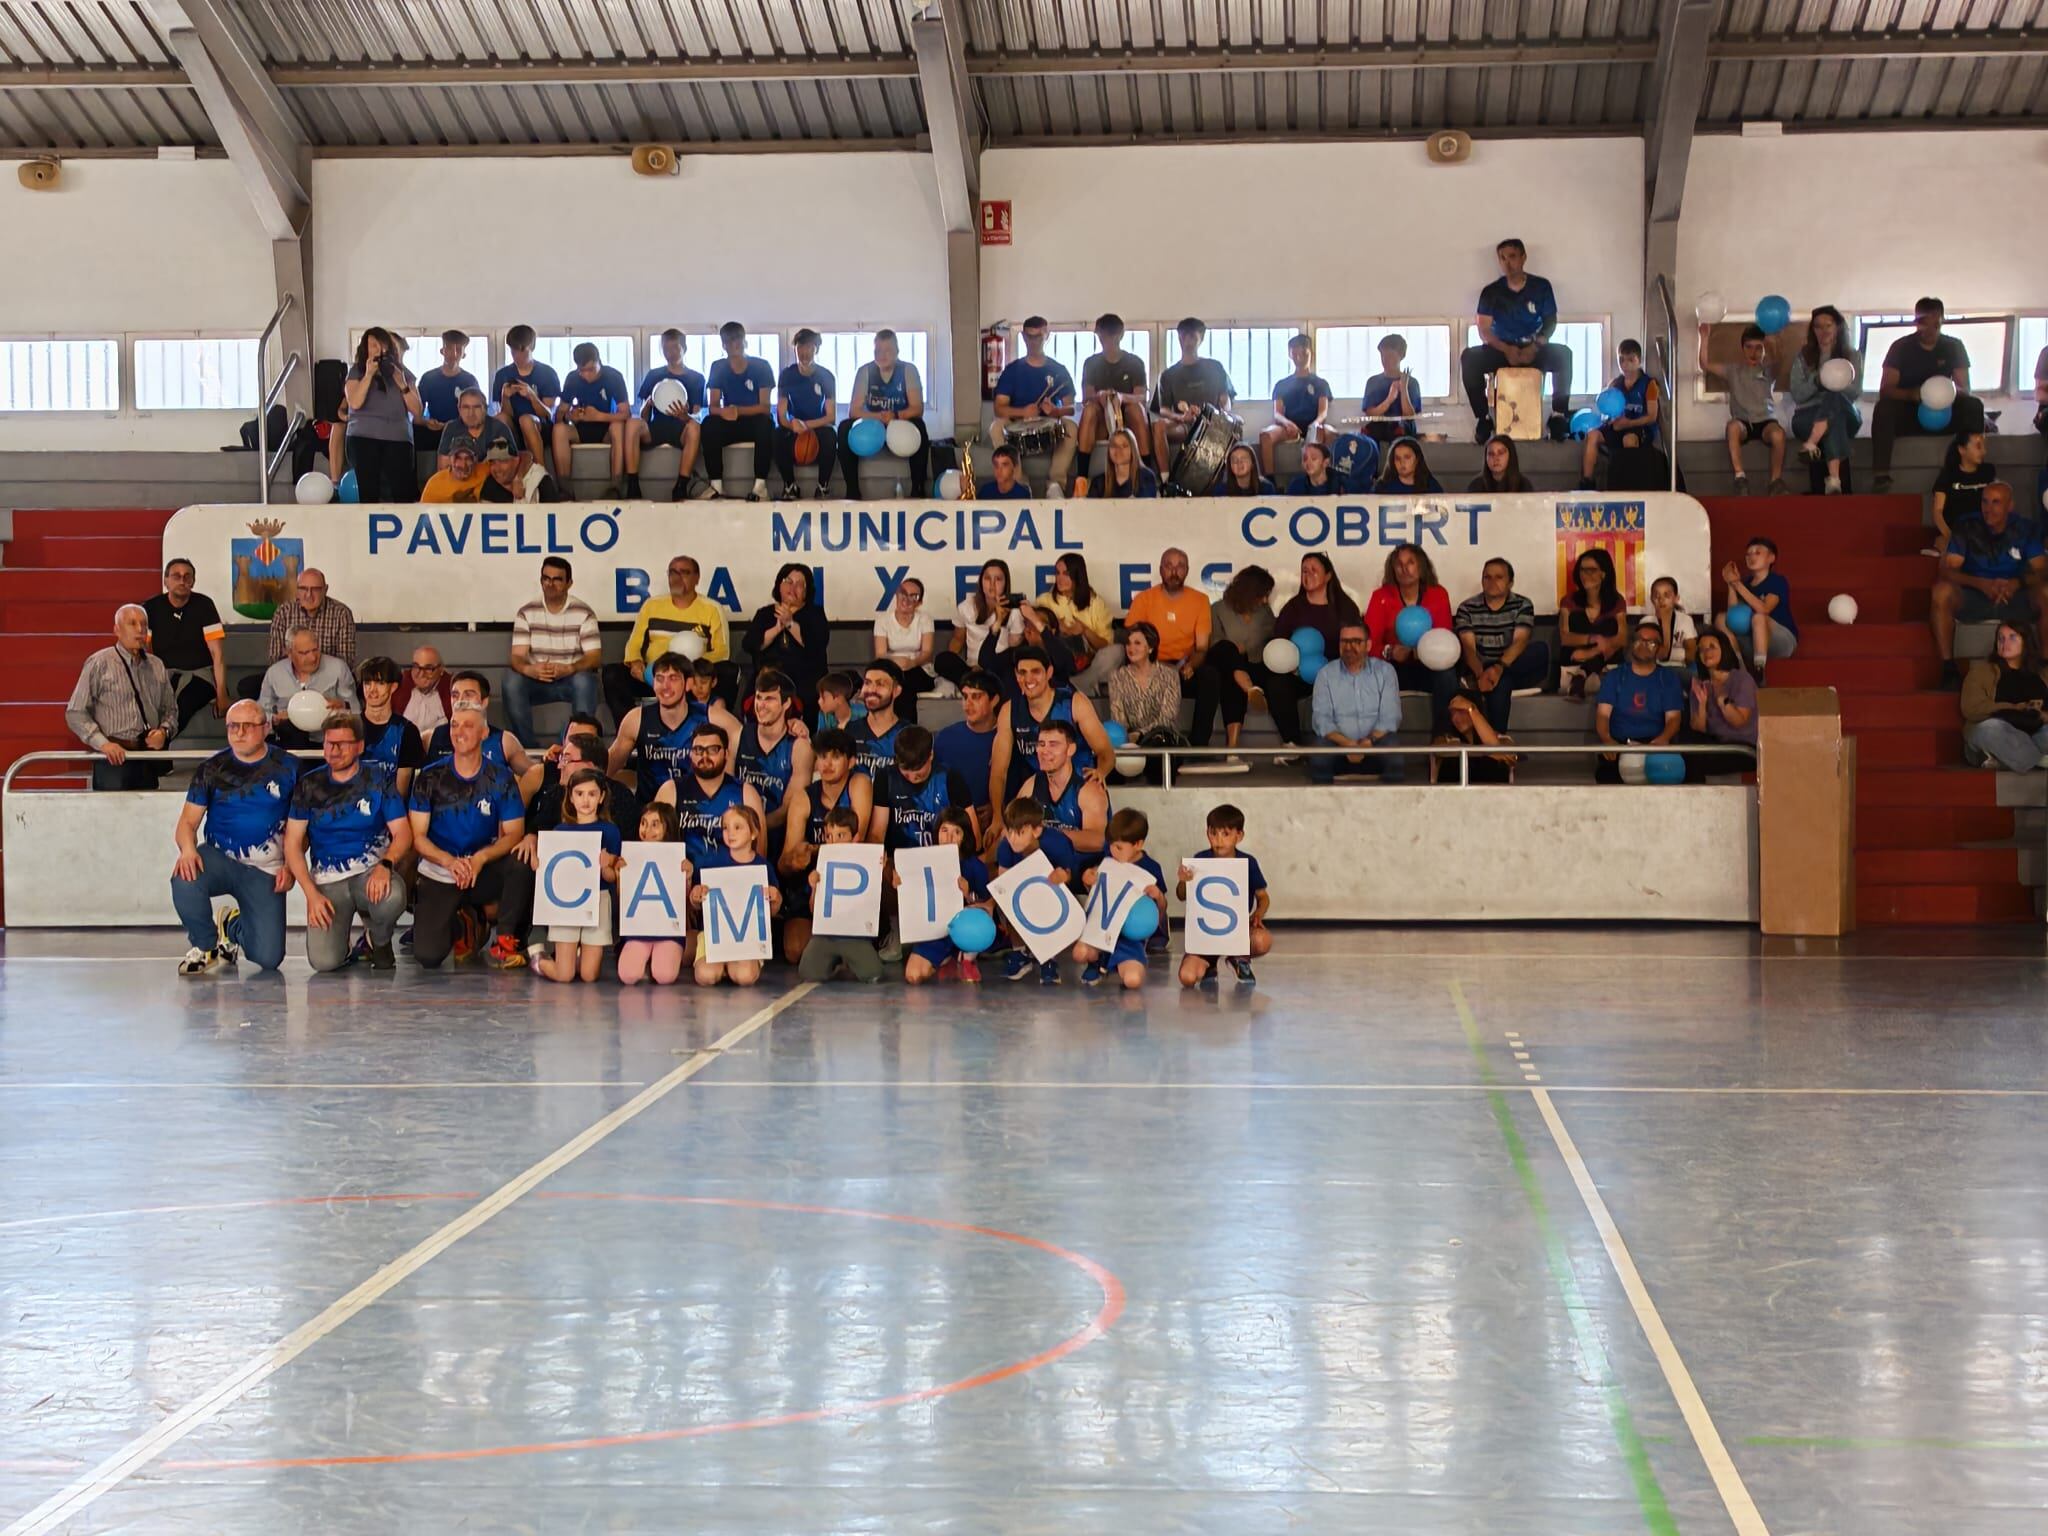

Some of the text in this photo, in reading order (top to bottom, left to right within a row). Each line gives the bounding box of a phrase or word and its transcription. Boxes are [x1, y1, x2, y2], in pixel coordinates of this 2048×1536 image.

[368, 504, 1492, 555] PAVELLÓ MUNICIPAL COBERT
